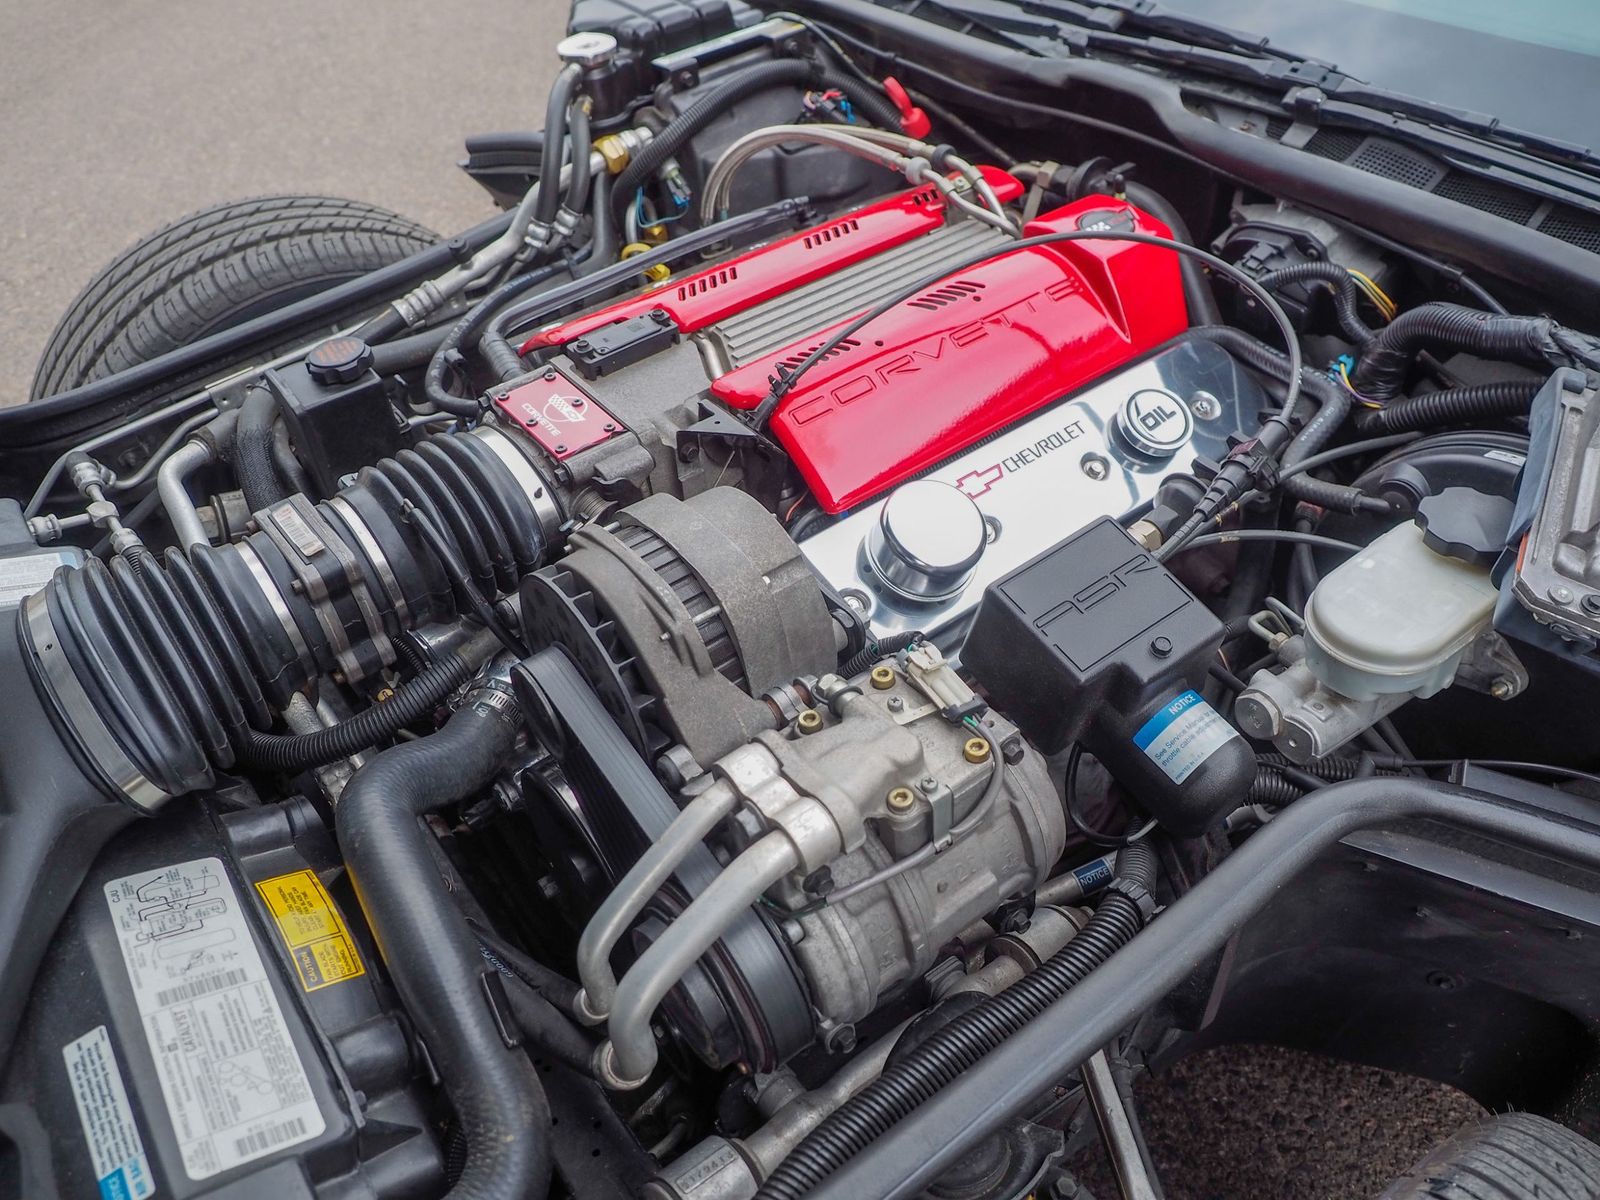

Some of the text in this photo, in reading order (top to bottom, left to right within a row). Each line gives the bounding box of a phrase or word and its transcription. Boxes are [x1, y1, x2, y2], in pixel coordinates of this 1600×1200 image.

[789, 275, 1086, 427] CORVETTE
[520, 402, 562, 437] CORVETTE
[1139, 405, 1177, 432] OIL
[1001, 421, 1086, 473] CHEVROLET
[1032, 553, 1158, 637] ASR
[1168, 694, 1196, 715] NOTICE
[1154, 748, 1168, 760] See
[1165, 729, 1188, 748] Service
[1161, 748, 1182, 767] throttle
[1180, 734, 1196, 748] cable
[1079, 868, 1110, 886] NOTICE
[110, 889, 120, 902] CJU
[301, 951, 318, 982] CAUTION
[174, 1009, 195, 1052] CATALYST
